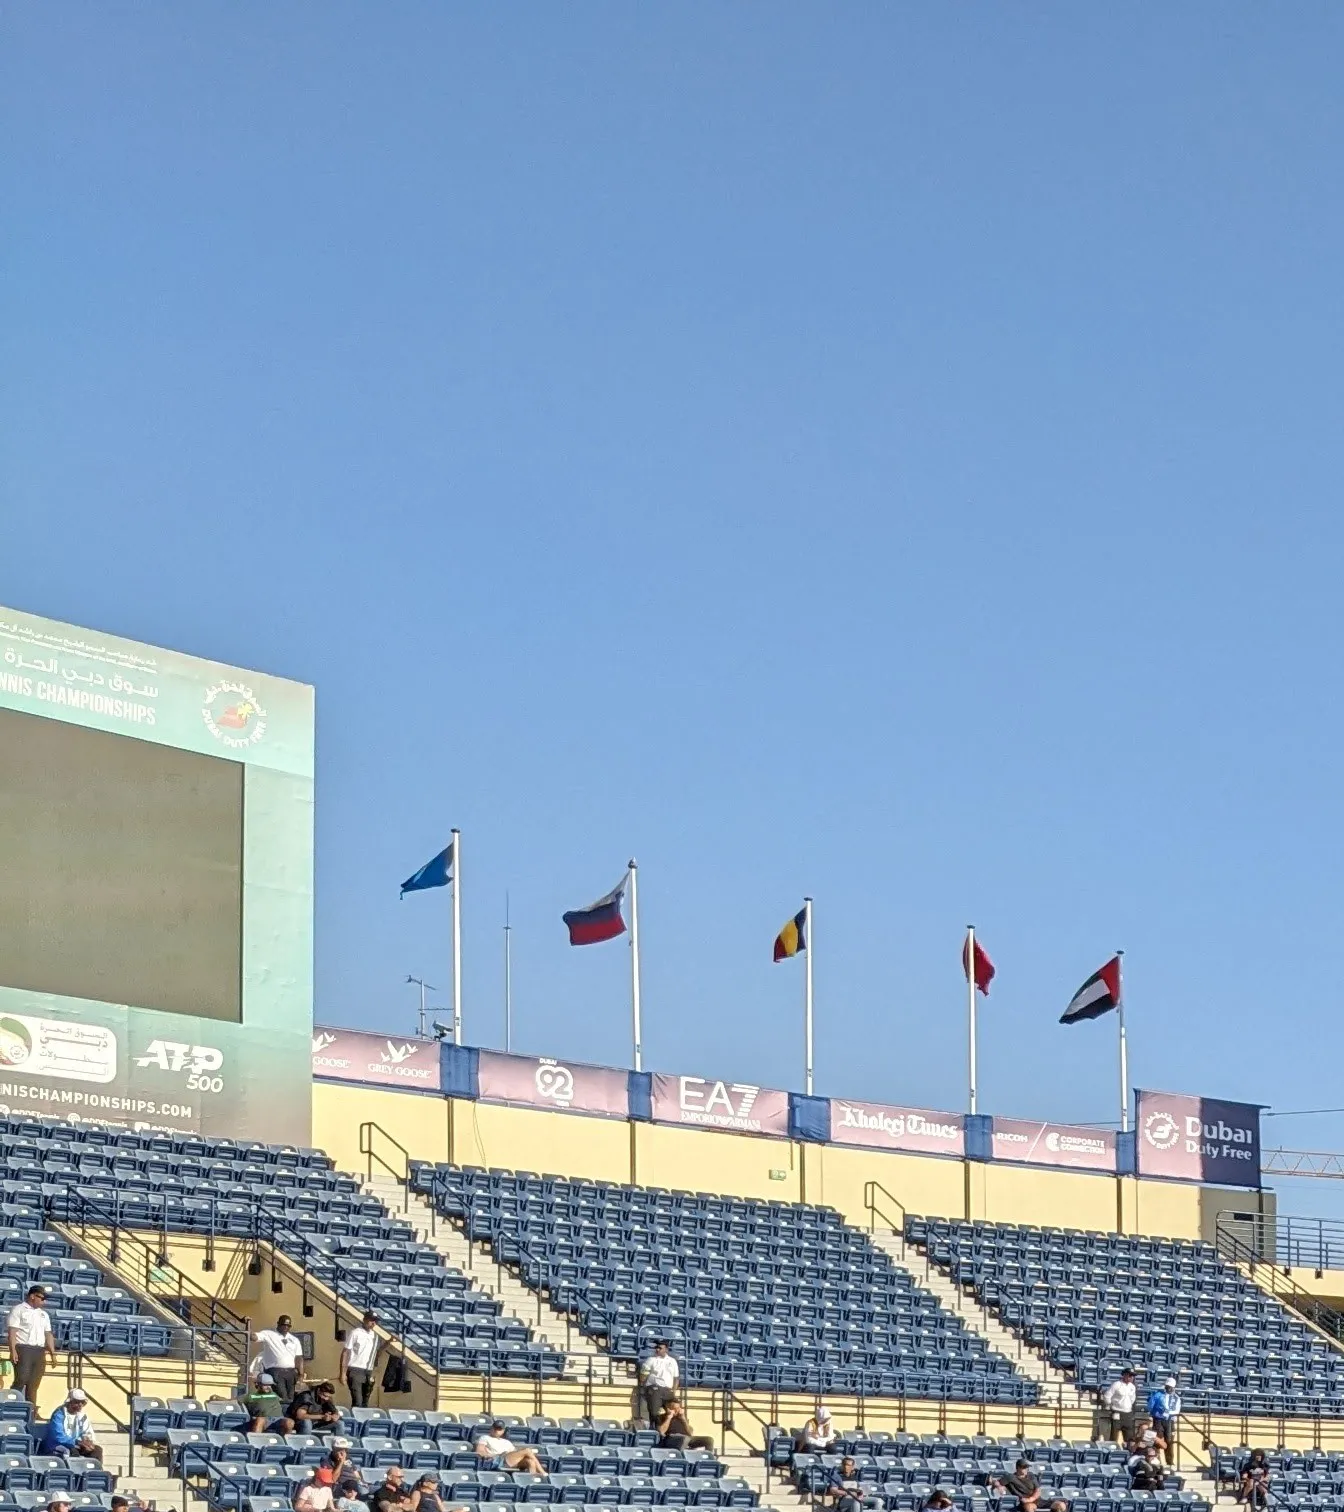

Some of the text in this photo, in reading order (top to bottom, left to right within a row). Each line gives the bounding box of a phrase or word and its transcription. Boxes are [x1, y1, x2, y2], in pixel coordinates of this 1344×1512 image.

[4, 647, 58, 675] الحرة
[62, 662, 105, 685] دبي
[37, 681, 156, 726] CHAMPIONSHIPS
[133, 1039, 223, 1074] ATP
[313, 1056, 350, 1069] GOOSE
[186, 1074, 223, 1093] 500
[368, 1062, 431, 1080] GREY GOOSE
[0, 1083, 192, 1118] NISCHAMPIONSHIPS.COM
[679, 1076, 760, 1117] EA7
[839, 1106, 958, 1140] Khaleej Times
[1185, 1116, 1252, 1144] Dubai
[996, 1132, 1028, 1143] RICOH
[1060, 1135, 1105, 1148] CORPORATE
[1186, 1140, 1252, 1161] Duty Free
